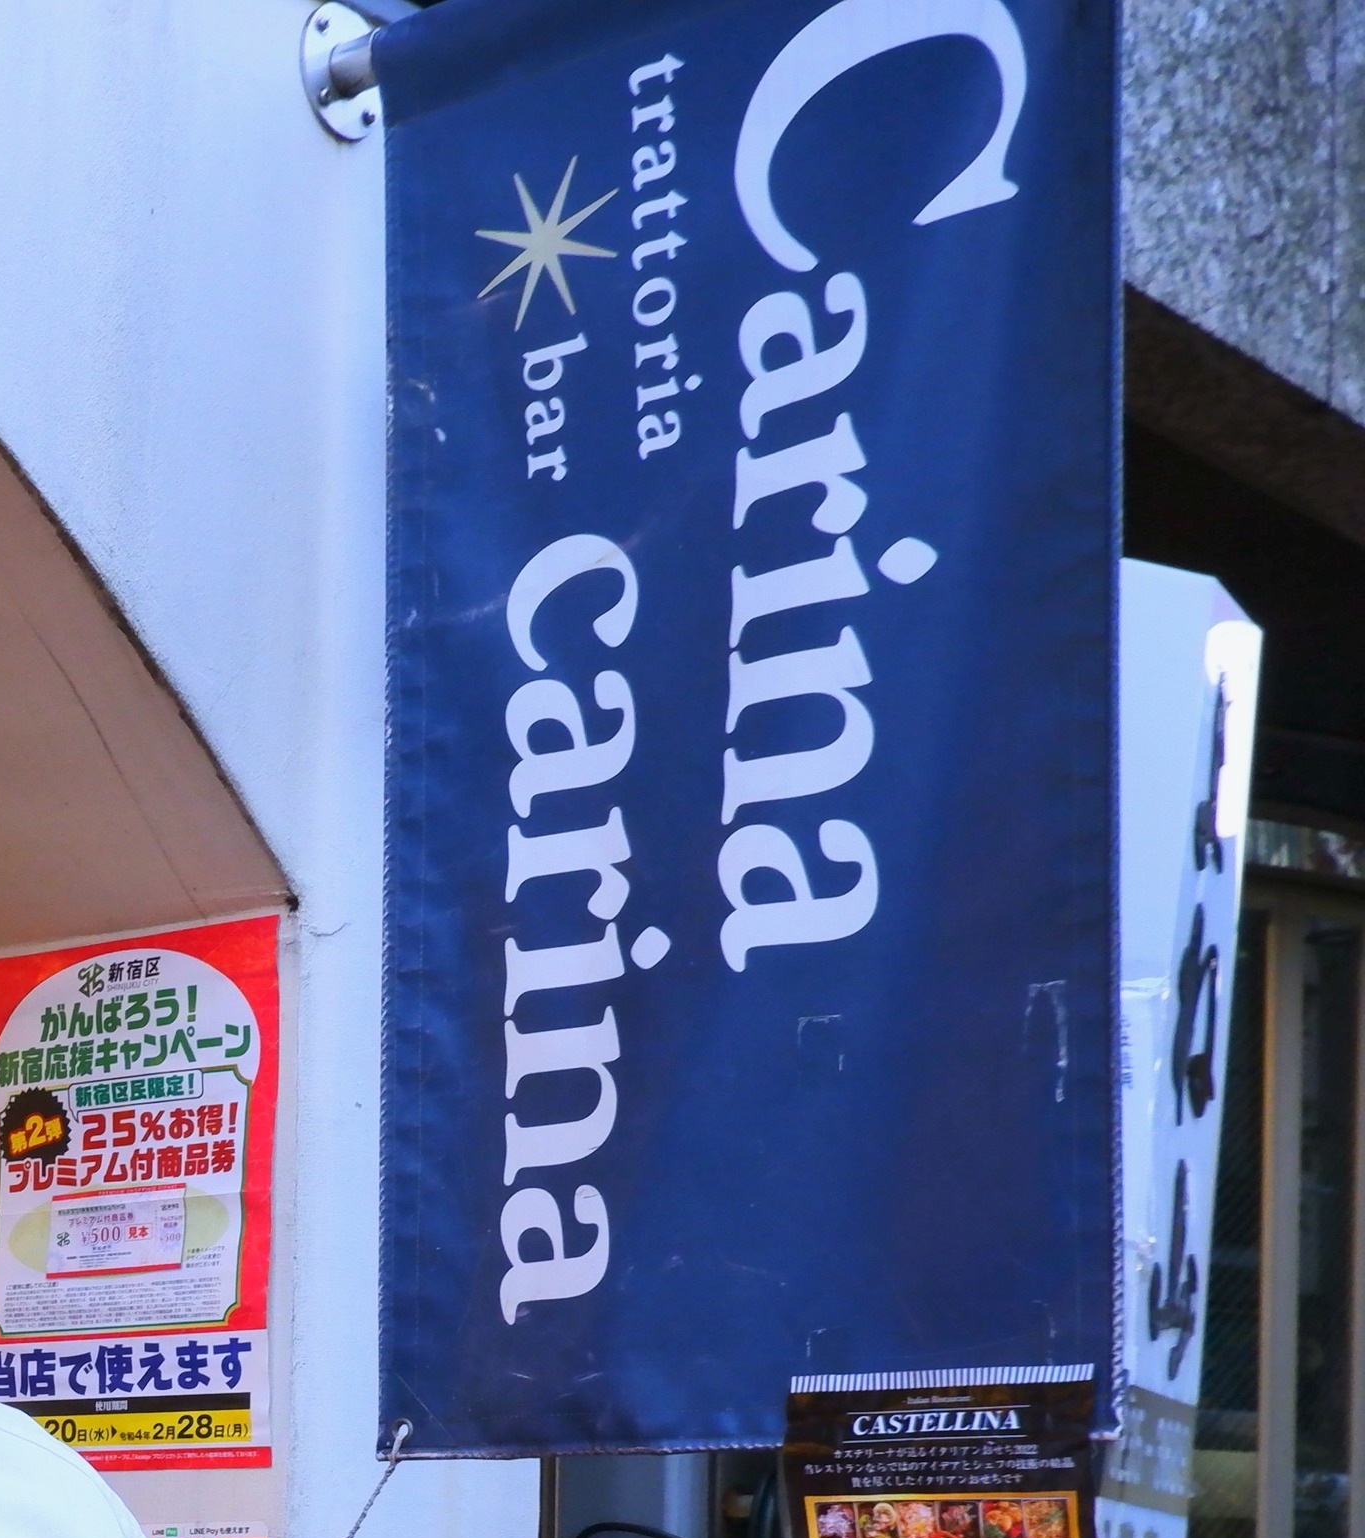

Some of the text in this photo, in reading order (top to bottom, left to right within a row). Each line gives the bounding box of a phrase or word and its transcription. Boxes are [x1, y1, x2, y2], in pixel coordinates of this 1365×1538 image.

[629, 52, 704, 460] trattoria
[718, 0, 1027, 973] Carina
[500, 333, 671, 1326] bar carina
[108, 955, 161, 983] 新宿区
[143, 977, 160, 988] CITY
[10, 1115, 63, 1153] 第2弾
[8, 1139, 236, 1193] プレミアム付商品券
[68, 1212, 134, 1227] プレミアム付商品券
[128, 1226, 149, 1239] 見本
[95, 1400, 129, 1412] 使用期間
[852, 1409, 1021, 1436] CASTELLINA
[189, 1526, 251, 1536] LINE Pay も使えます
